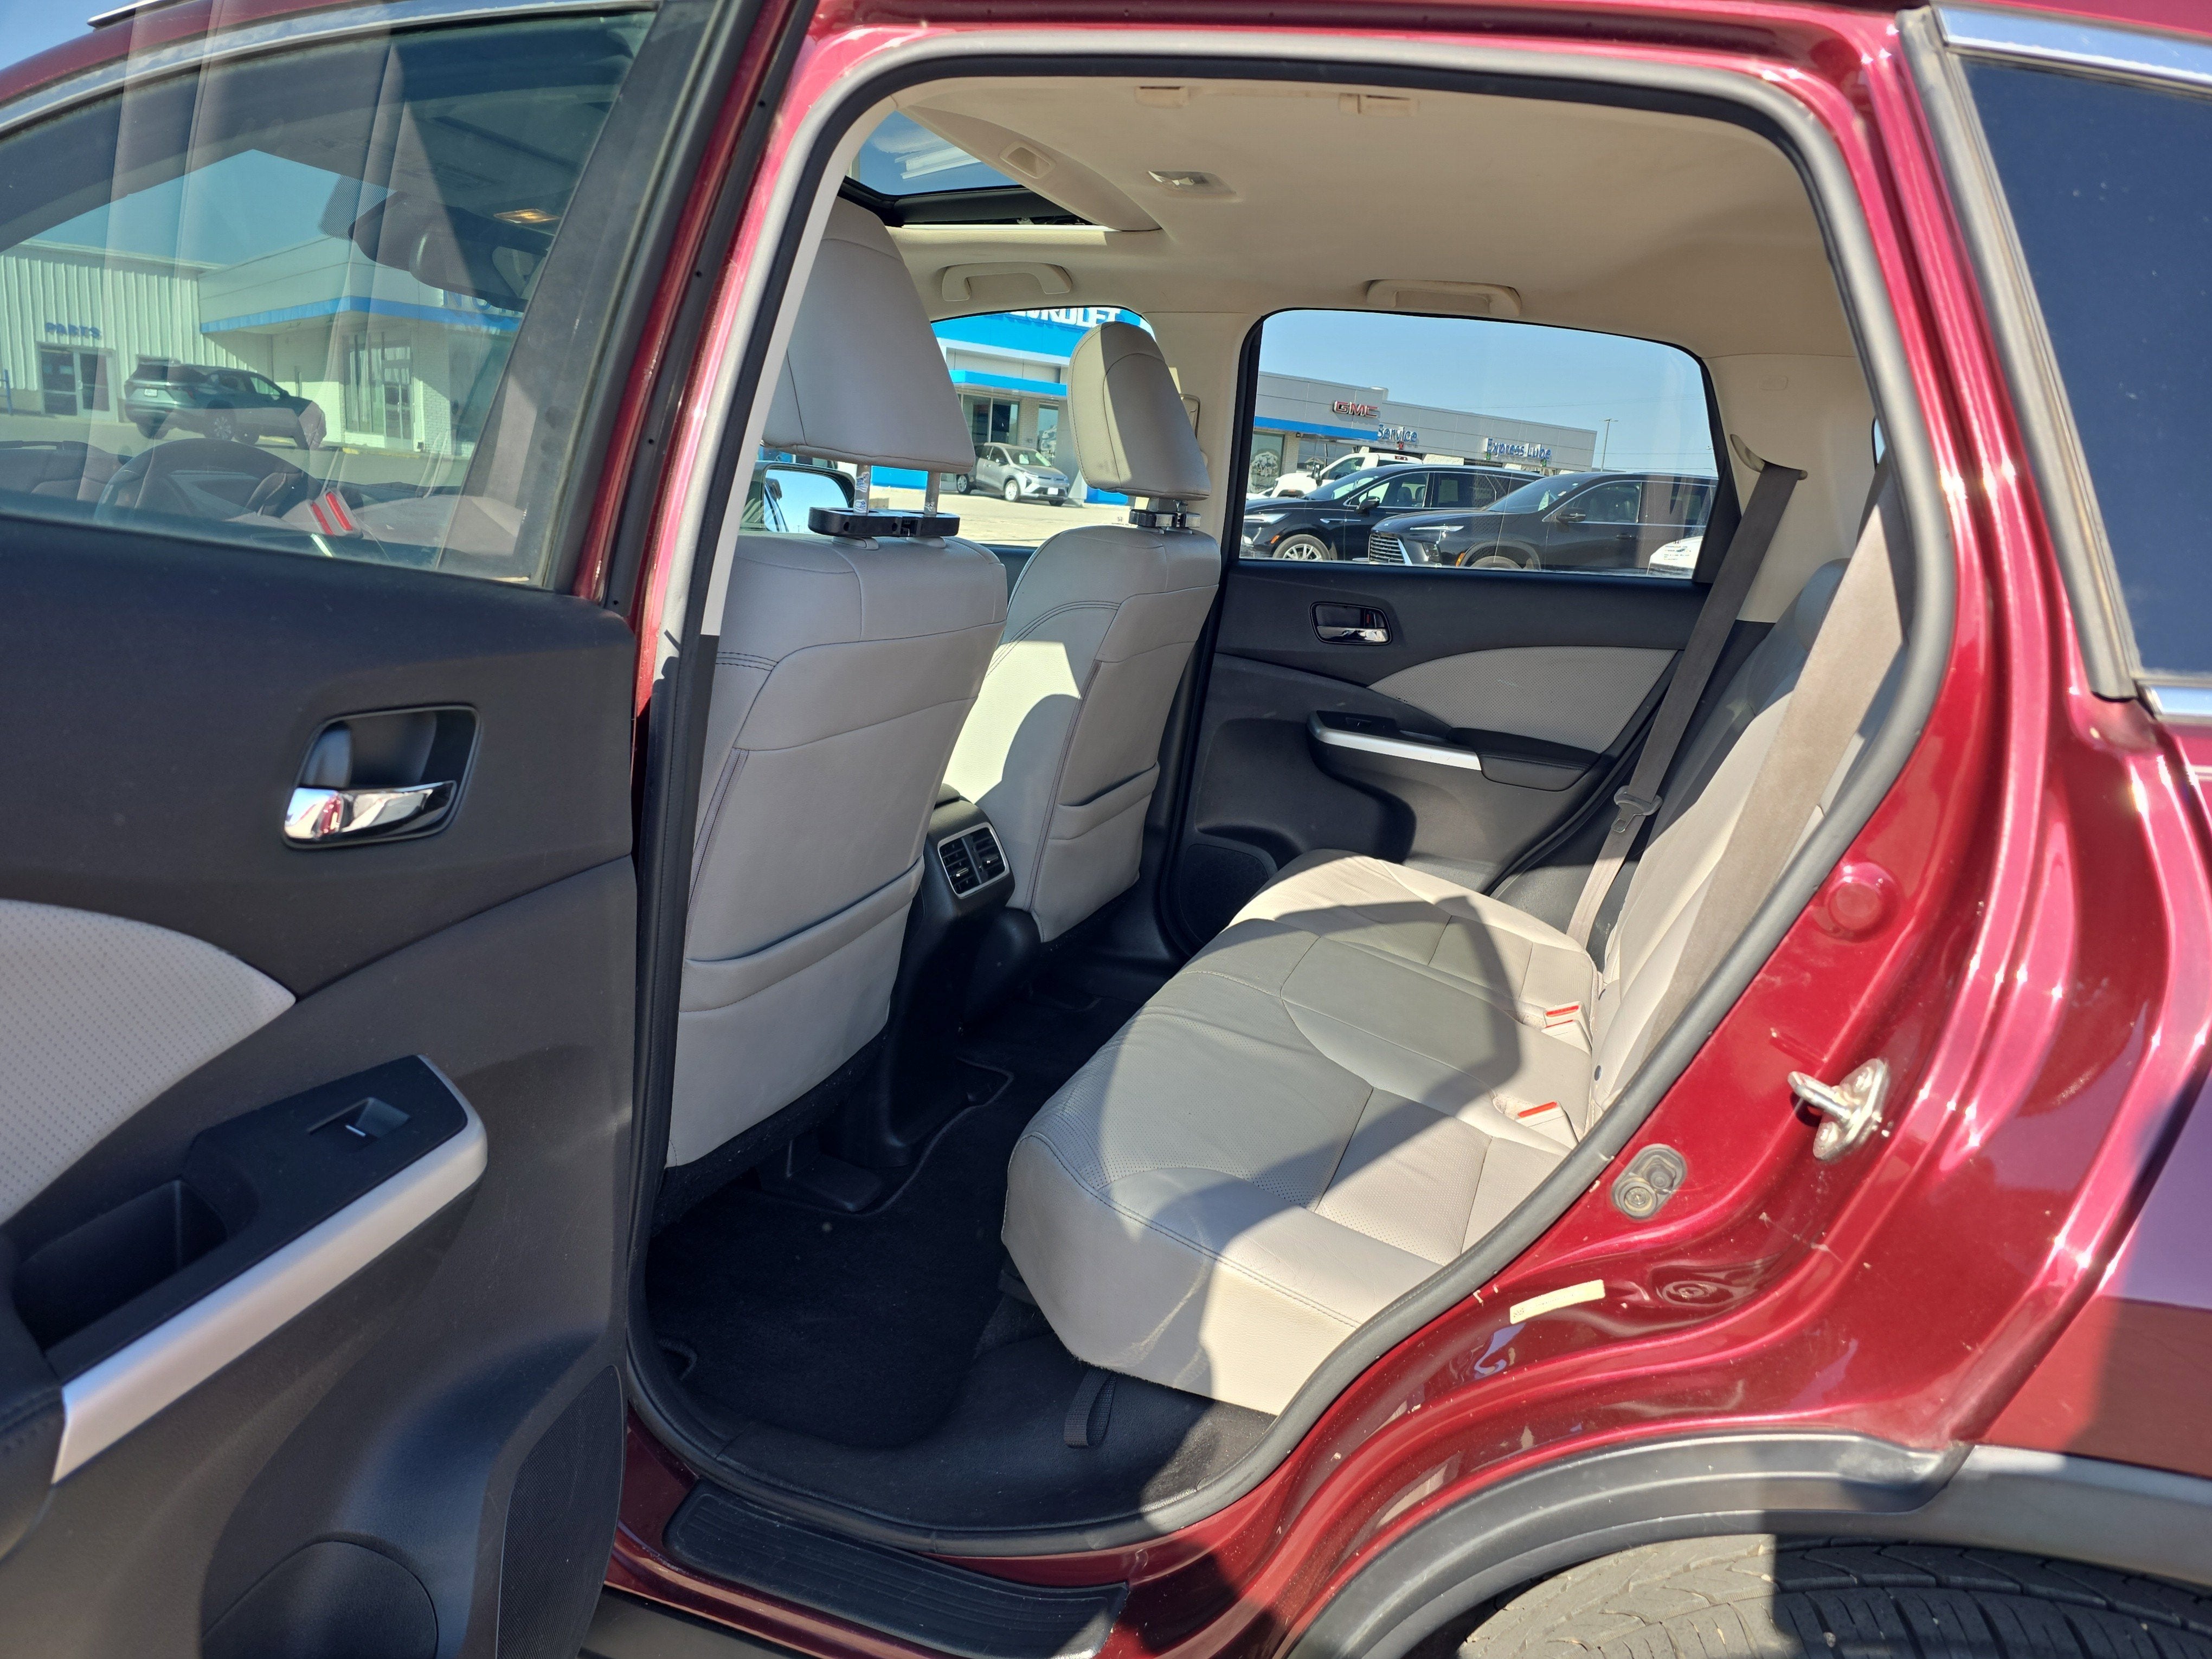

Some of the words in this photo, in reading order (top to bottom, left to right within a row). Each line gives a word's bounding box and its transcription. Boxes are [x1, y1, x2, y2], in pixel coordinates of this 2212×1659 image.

[45, 322, 101, 340] PARTS
[1334, 400, 1379, 418] GMC
[1378, 423, 1417, 442] Service
[1484, 438, 1525, 457] Express
[1524, 443, 1551, 459] Lube
